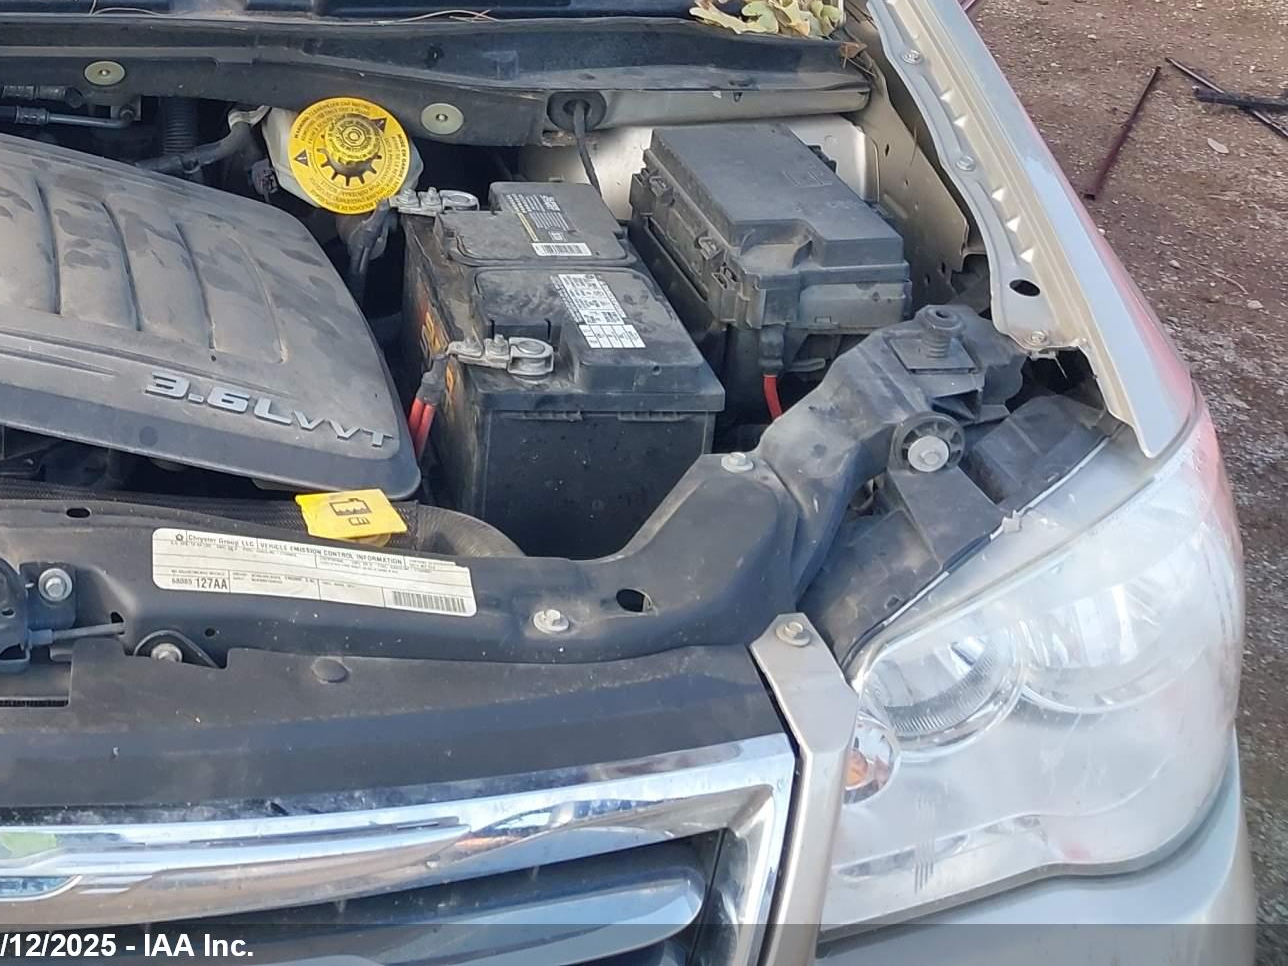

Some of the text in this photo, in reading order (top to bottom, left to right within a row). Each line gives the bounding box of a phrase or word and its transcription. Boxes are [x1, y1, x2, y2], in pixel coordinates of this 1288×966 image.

[218, 538, 239, 547] Group
[260, 543, 288, 551] VEHICLE
[289, 546, 322, 555] EMISSION
[323, 549, 354, 560] CONTROL
[357, 554, 403, 565] INFORMATION
[196, 578, 228, 590] 127AA
